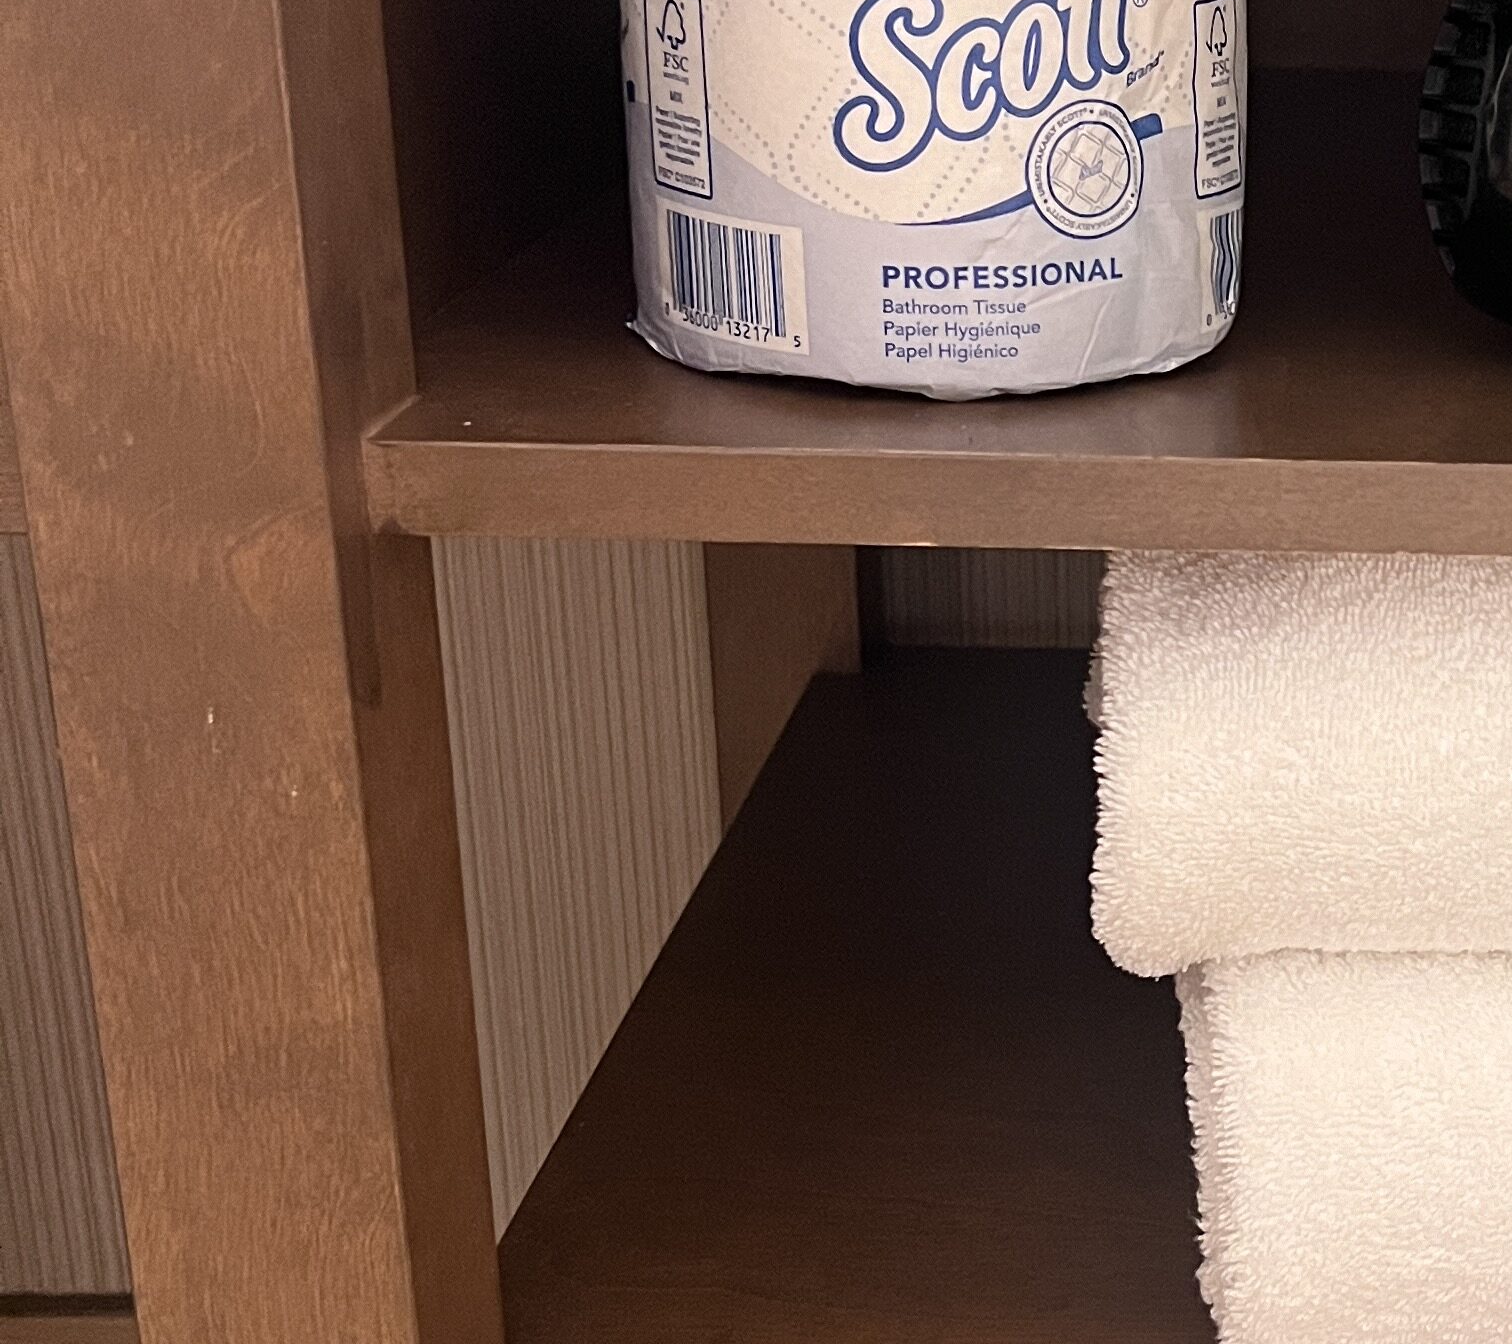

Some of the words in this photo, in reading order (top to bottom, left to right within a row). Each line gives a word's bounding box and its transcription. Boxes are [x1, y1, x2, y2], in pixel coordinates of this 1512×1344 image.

[663, 51, 689, 72] FSC
[1212, 57, 1230, 77] FSC
[882, 257, 1123, 290] PROFESSIONAL
[882, 298, 969, 315] Bathroom
[973, 299, 1027, 315] Tissue
[726, 320, 770, 342] 13217
[793, 335, 801, 347] 5
[884, 321, 938, 340] Papier
[944, 321, 1041, 341] Hygiénique
[885, 343, 932, 363] Papel
[938, 343, 1019, 363] Higiénico
